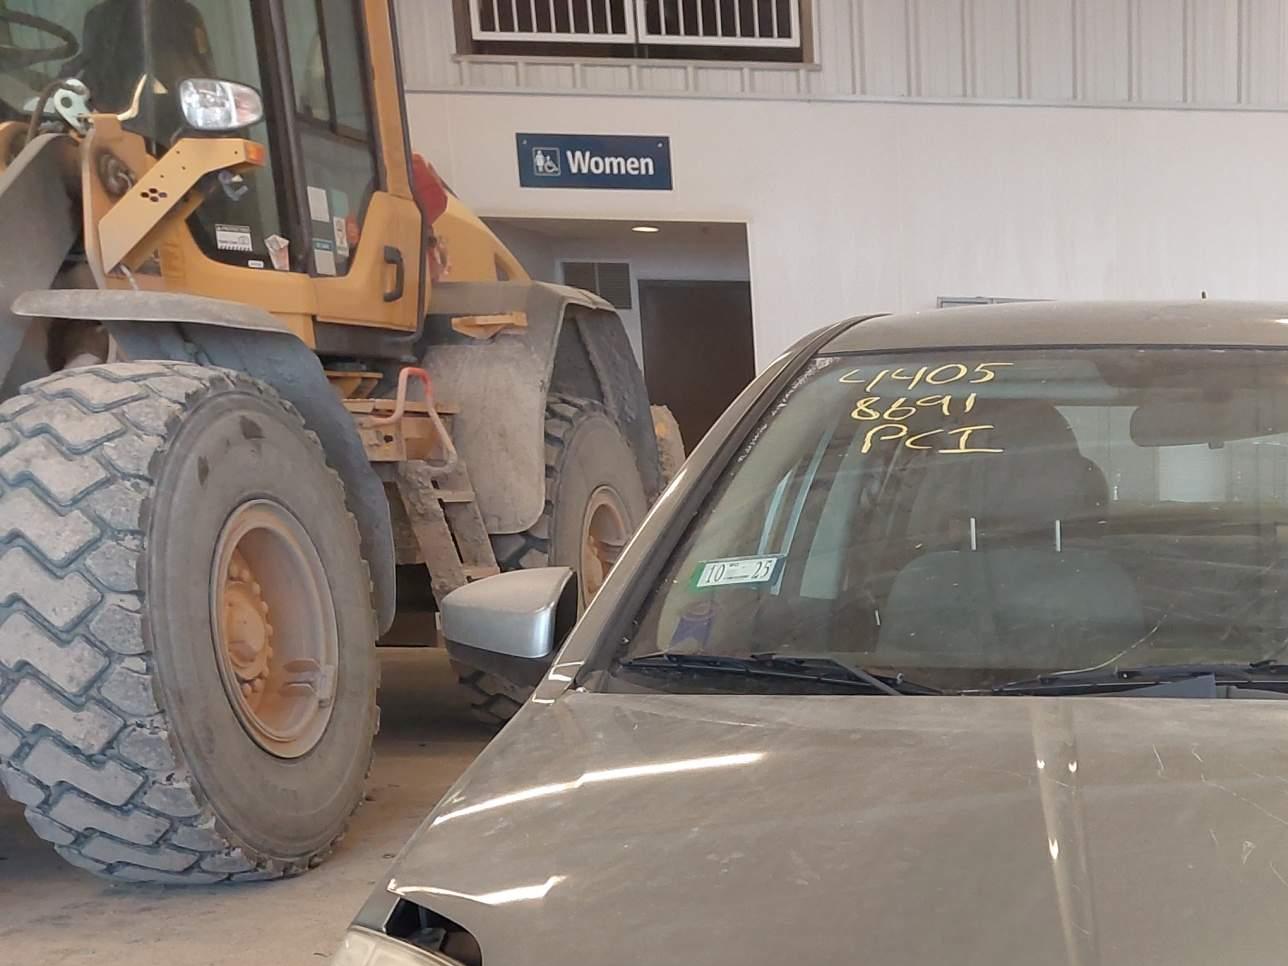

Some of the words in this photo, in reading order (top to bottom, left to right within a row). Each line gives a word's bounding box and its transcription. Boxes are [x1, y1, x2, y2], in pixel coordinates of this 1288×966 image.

[566, 150, 654, 175] Women
[851, 393, 977, 421] 8691
[861, 424, 1004, 454] PCI
[706, 564, 726, 583] 10
[750, 561, 772, 579] 25
